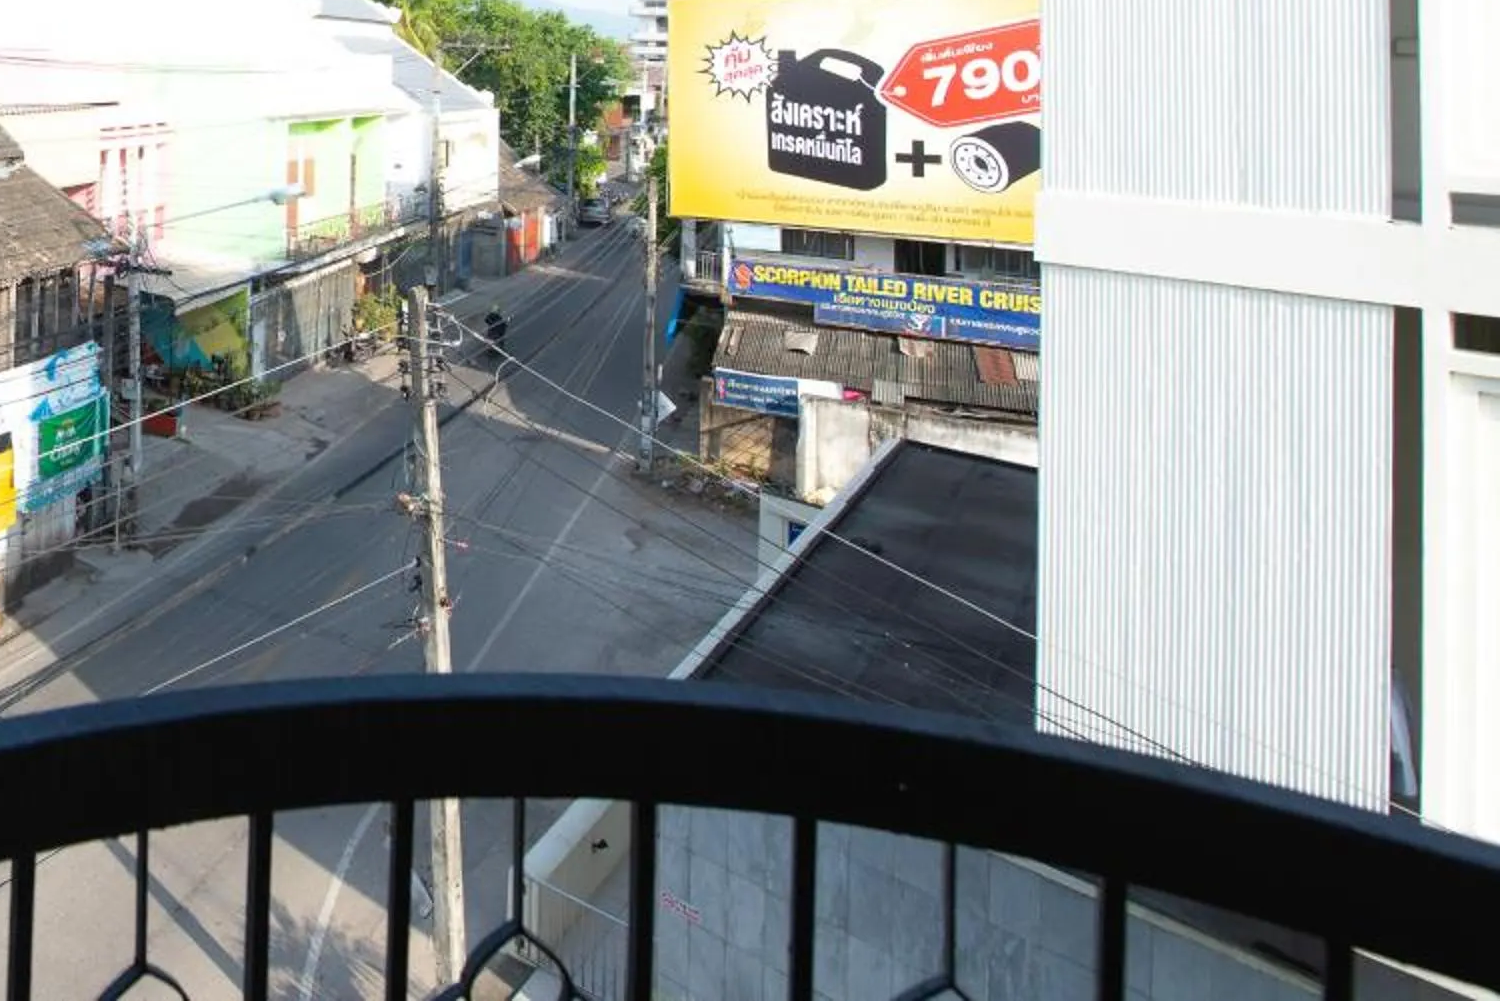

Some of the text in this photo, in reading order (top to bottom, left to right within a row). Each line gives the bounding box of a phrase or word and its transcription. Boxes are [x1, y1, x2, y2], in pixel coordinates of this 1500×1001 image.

[771, 92, 864, 136] สังเคราะห์
[753, 264, 1041, 314] SCORPION TAILED RIVER CRUIS
